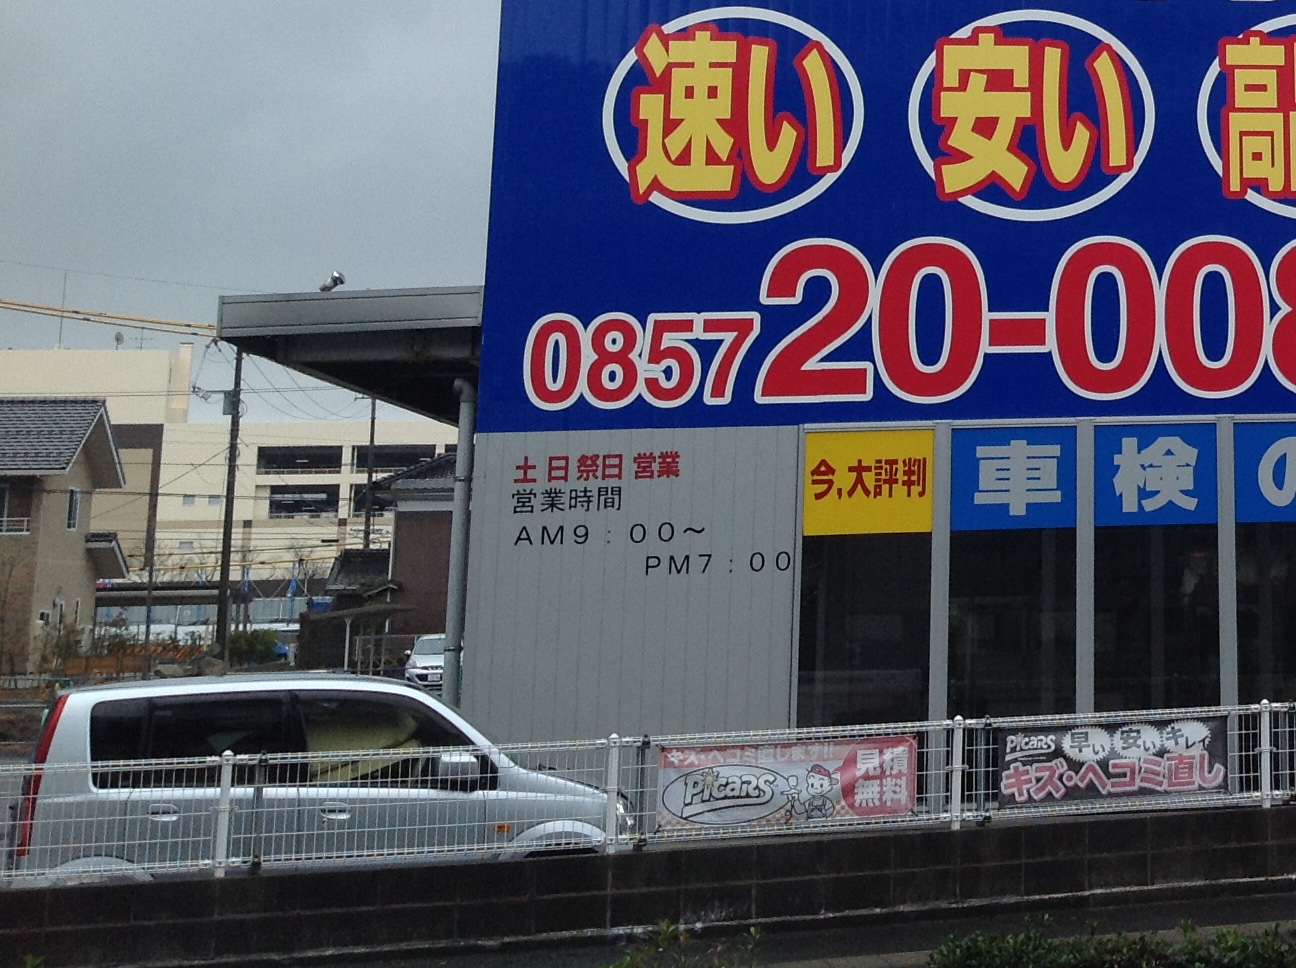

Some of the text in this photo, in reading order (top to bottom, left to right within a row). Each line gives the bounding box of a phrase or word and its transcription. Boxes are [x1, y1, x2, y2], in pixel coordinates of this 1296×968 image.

[627, 23, 842, 203] 速い
[934, 26, 1135, 202] 安い
[523, 311, 760, 411] 0857
[511, 486, 622, 515] 営業時間
[1069, 731, 1108, 756] 早い
[1120, 727, 1157, 753] 安い
[854, 777, 909, 808] 無料
